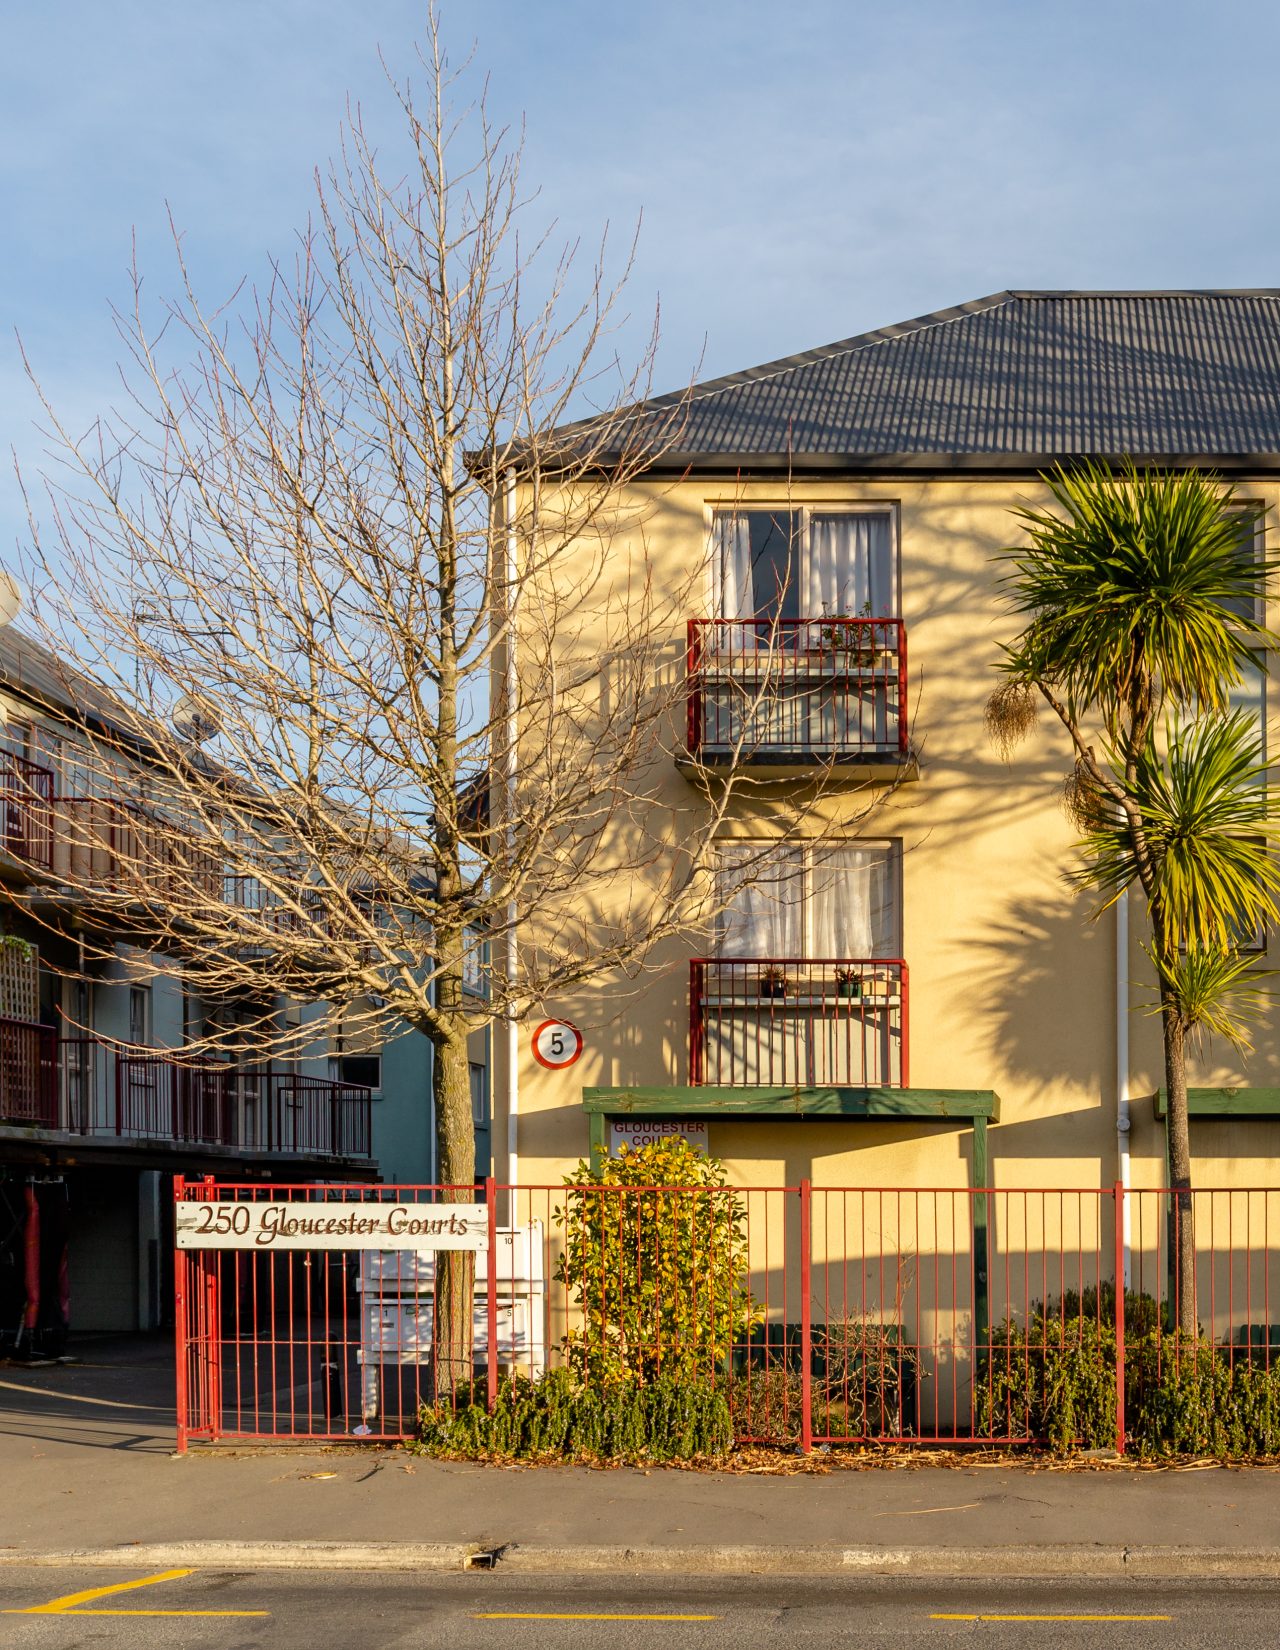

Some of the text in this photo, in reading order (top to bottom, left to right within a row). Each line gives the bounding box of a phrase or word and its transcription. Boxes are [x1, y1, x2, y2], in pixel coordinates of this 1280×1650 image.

[551, 1032, 564, 1055] 5
[614, 1122, 705, 1133] GLOUCESTER
[195, 1206, 469, 1245] 250 Gloucester Courts
